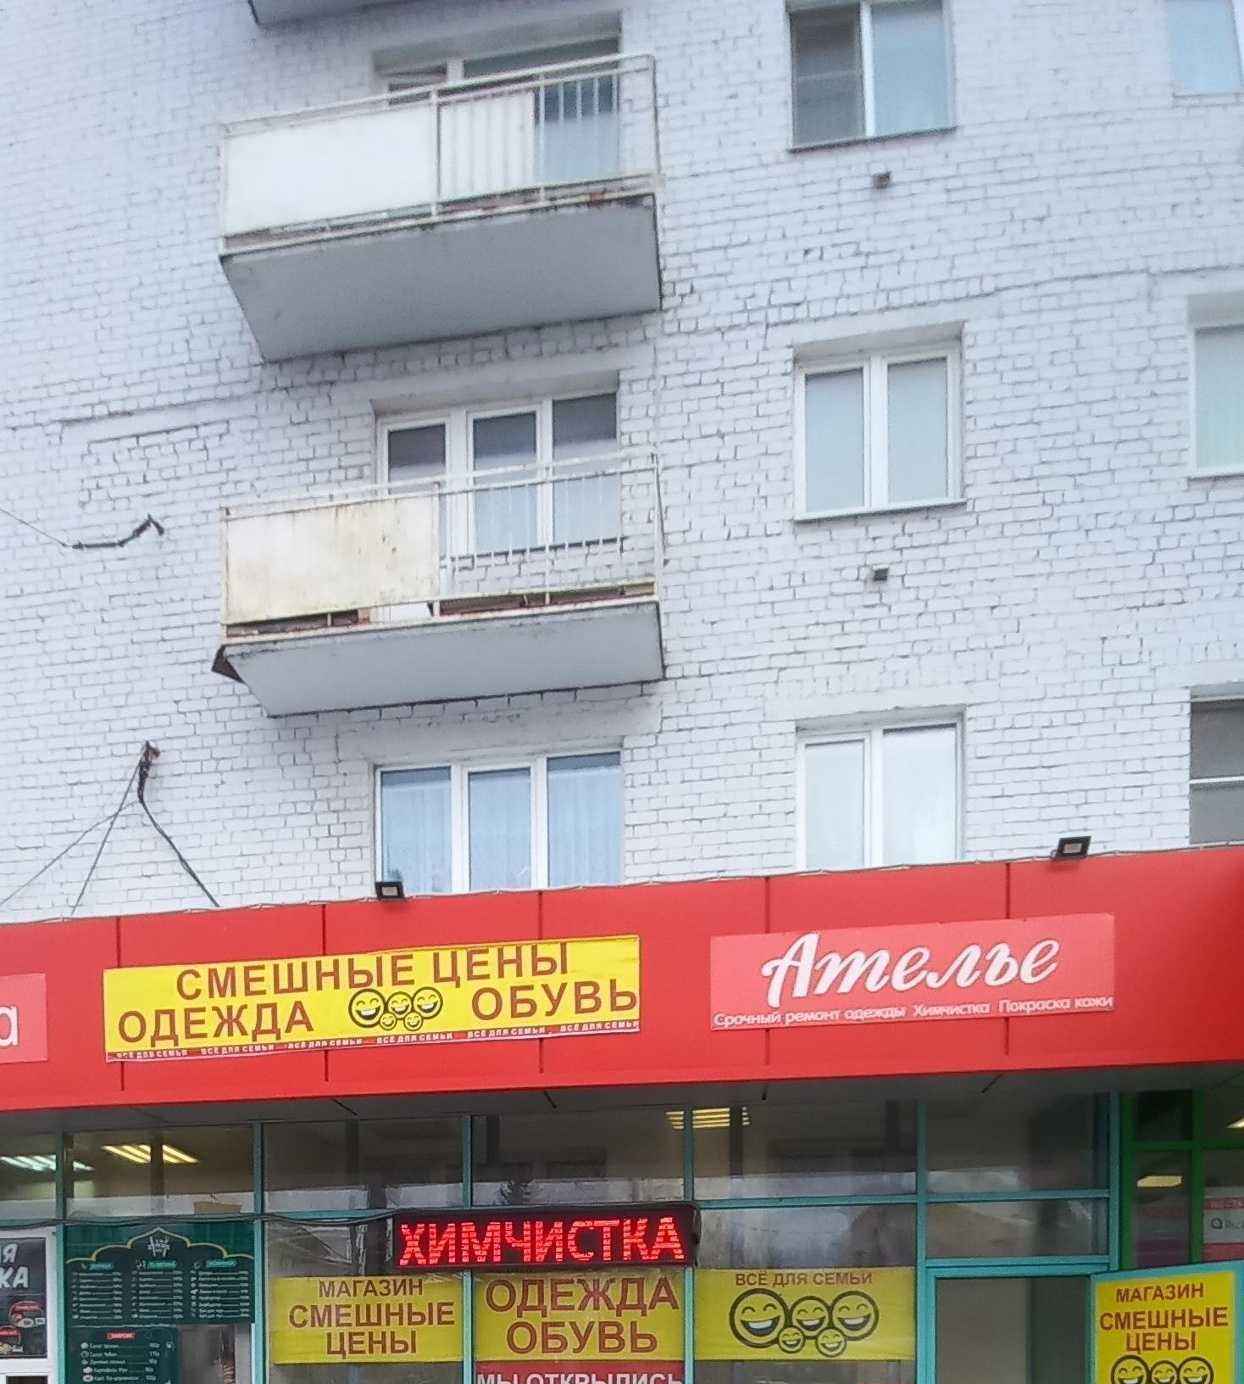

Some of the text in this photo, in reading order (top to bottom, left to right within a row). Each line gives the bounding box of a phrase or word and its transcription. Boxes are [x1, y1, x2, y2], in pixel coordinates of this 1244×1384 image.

[177, 942, 567, 1001] СМЕШНЫЕ ЦЕНЫ
[761, 932, 1060, 1008] Ателье
[118, 979, 637, 1047] ОДЕЖДА ОБУВЬ
[714, 996, 1113, 1027] Срочный ремонт одежды Химчистка Покраска кожи
[399, 1217, 685, 1265] ХИМЧИСТКА
[318, 1278, 424, 1298] МАГАЗИН
[735, 1271, 872, 1288] ВСЁ ДЛЯ СЕМЬИ
[1115, 1282, 1205, 1303] МАГАЗИН
[485, 1277, 679, 1318] ОДЕЖДА
[288, 1302, 456, 1329] СМЕШНЫЕ
[1100, 1306, 1229, 1331] СМЕШНЫЕ
[326, 1330, 417, 1359] ЦЕНЫ
[506, 1321, 658, 1354] ОБУВЬ
[1126, 1331, 1196, 1354] ЦЕНЫ
